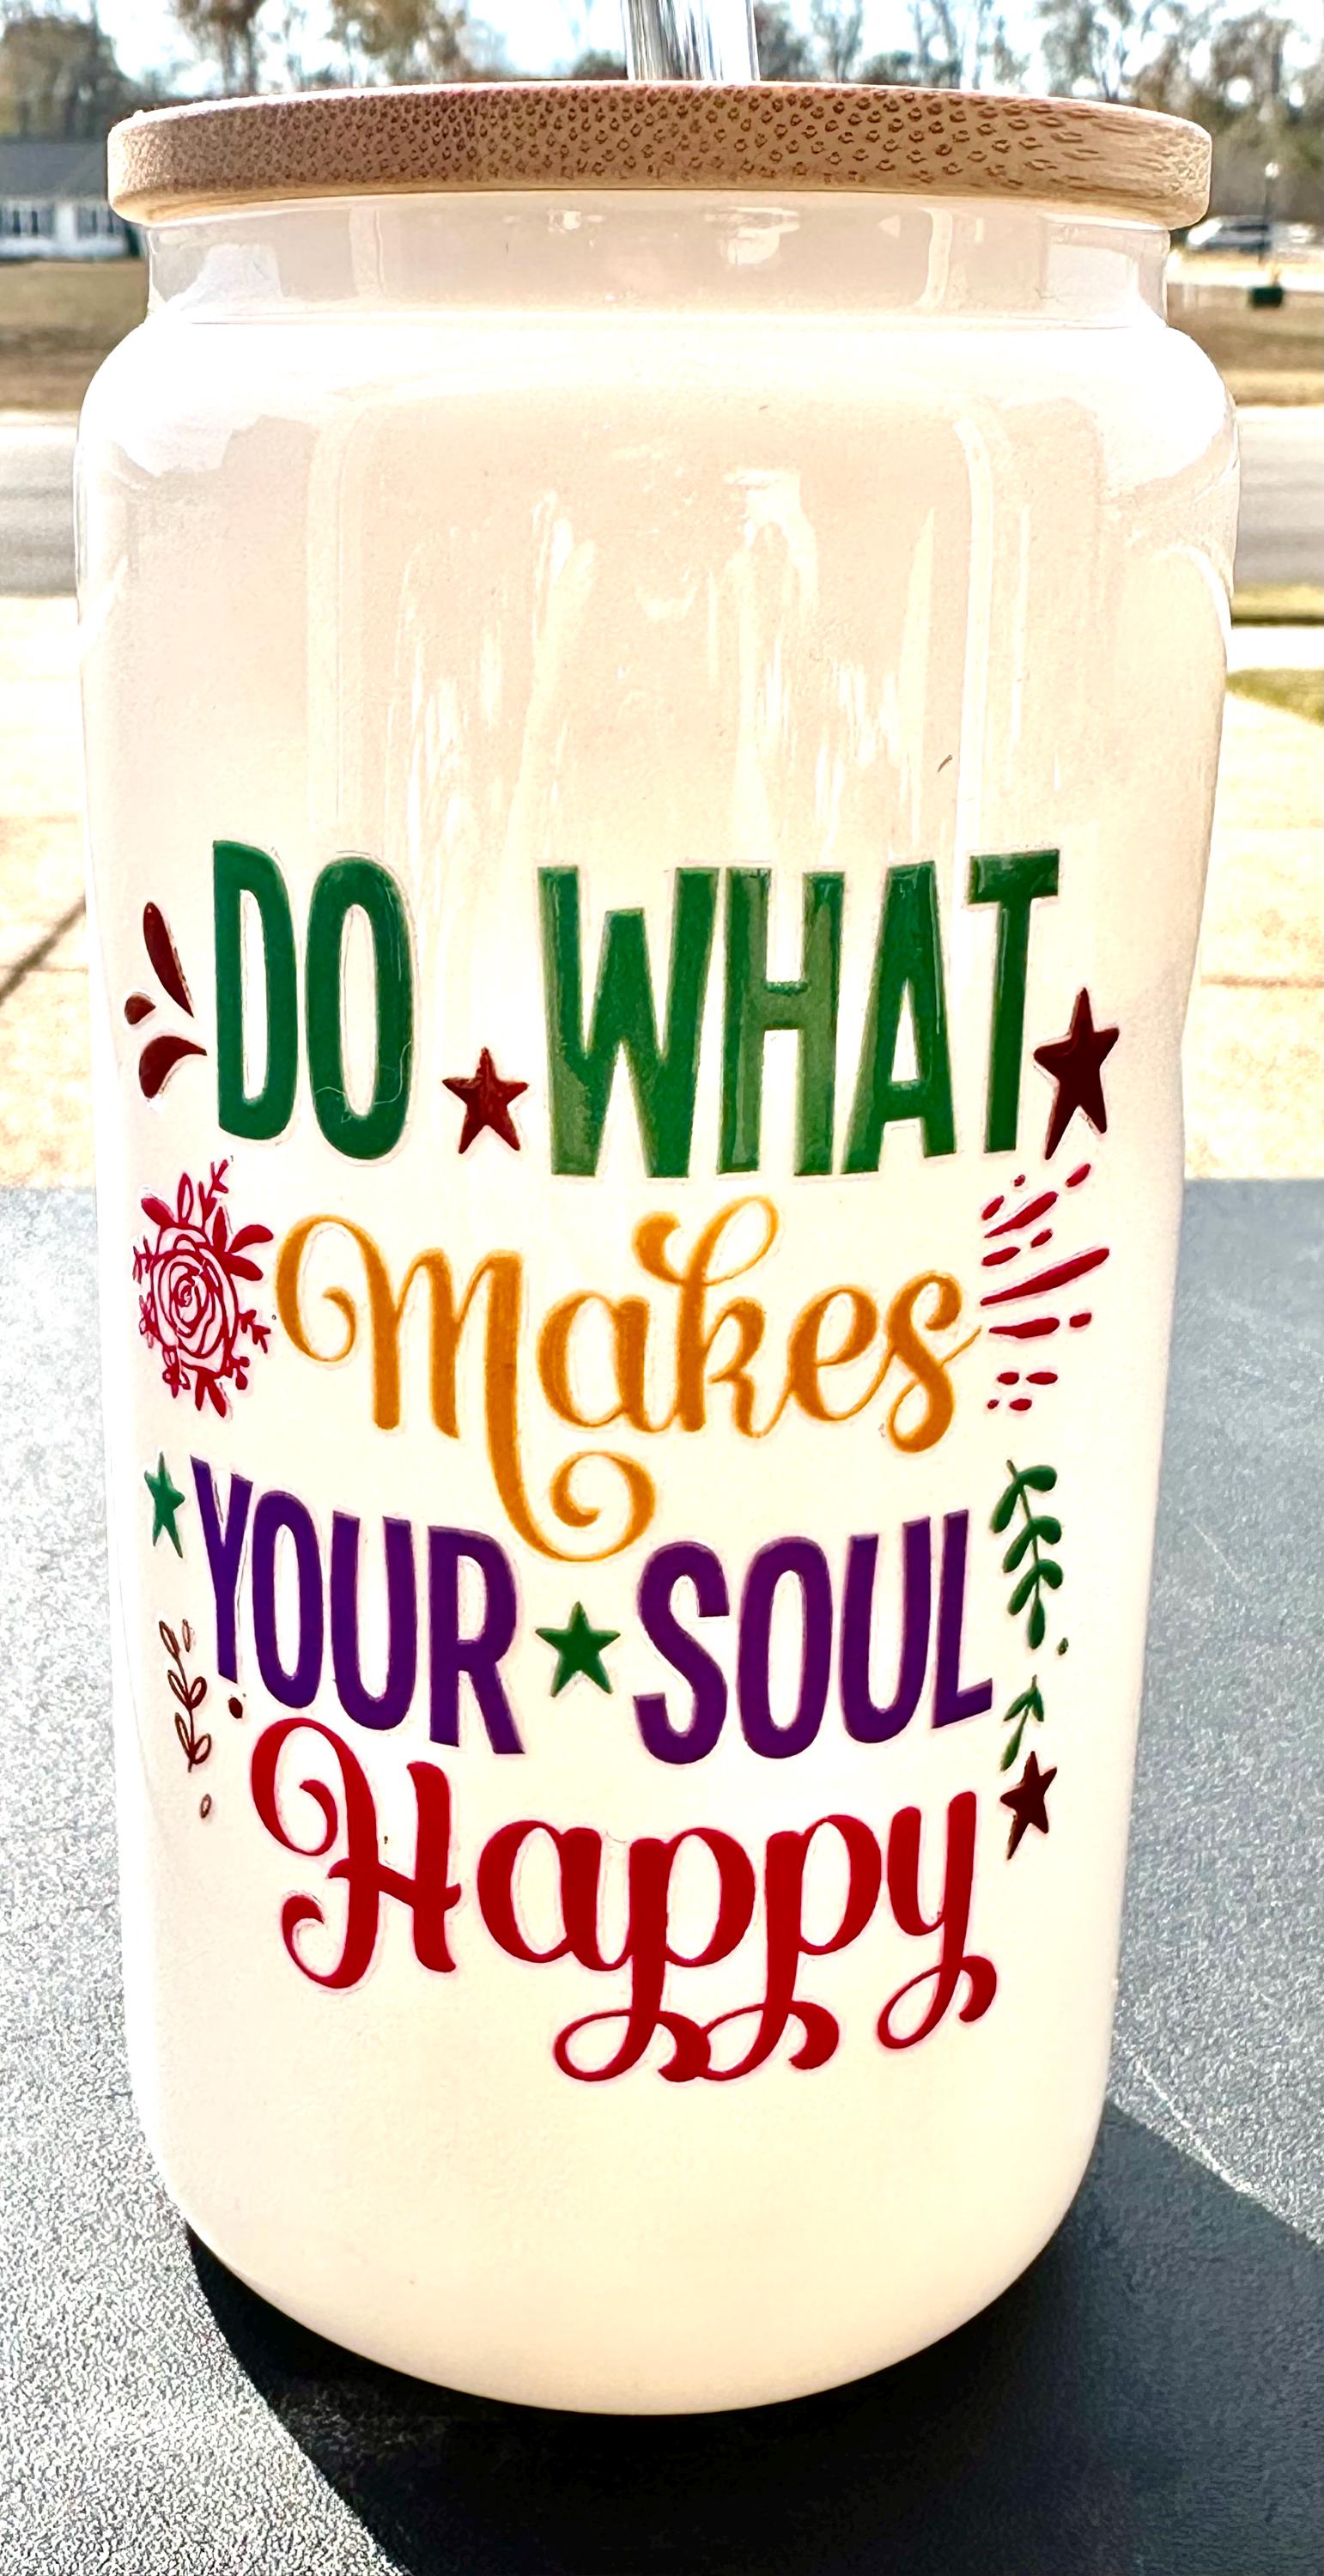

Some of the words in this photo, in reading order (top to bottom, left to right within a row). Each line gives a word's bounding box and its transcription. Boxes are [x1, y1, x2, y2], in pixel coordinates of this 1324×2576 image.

[213, 840, 414, 1159] DO
[538, 849, 1060, 1178] WHAT
[275, 1195, 981, 1563] Makes
[191, 1455, 525, 1756] YOUR
[633, 1510, 993, 1765] SOUL
[250, 1716, 998, 2083] Happy
